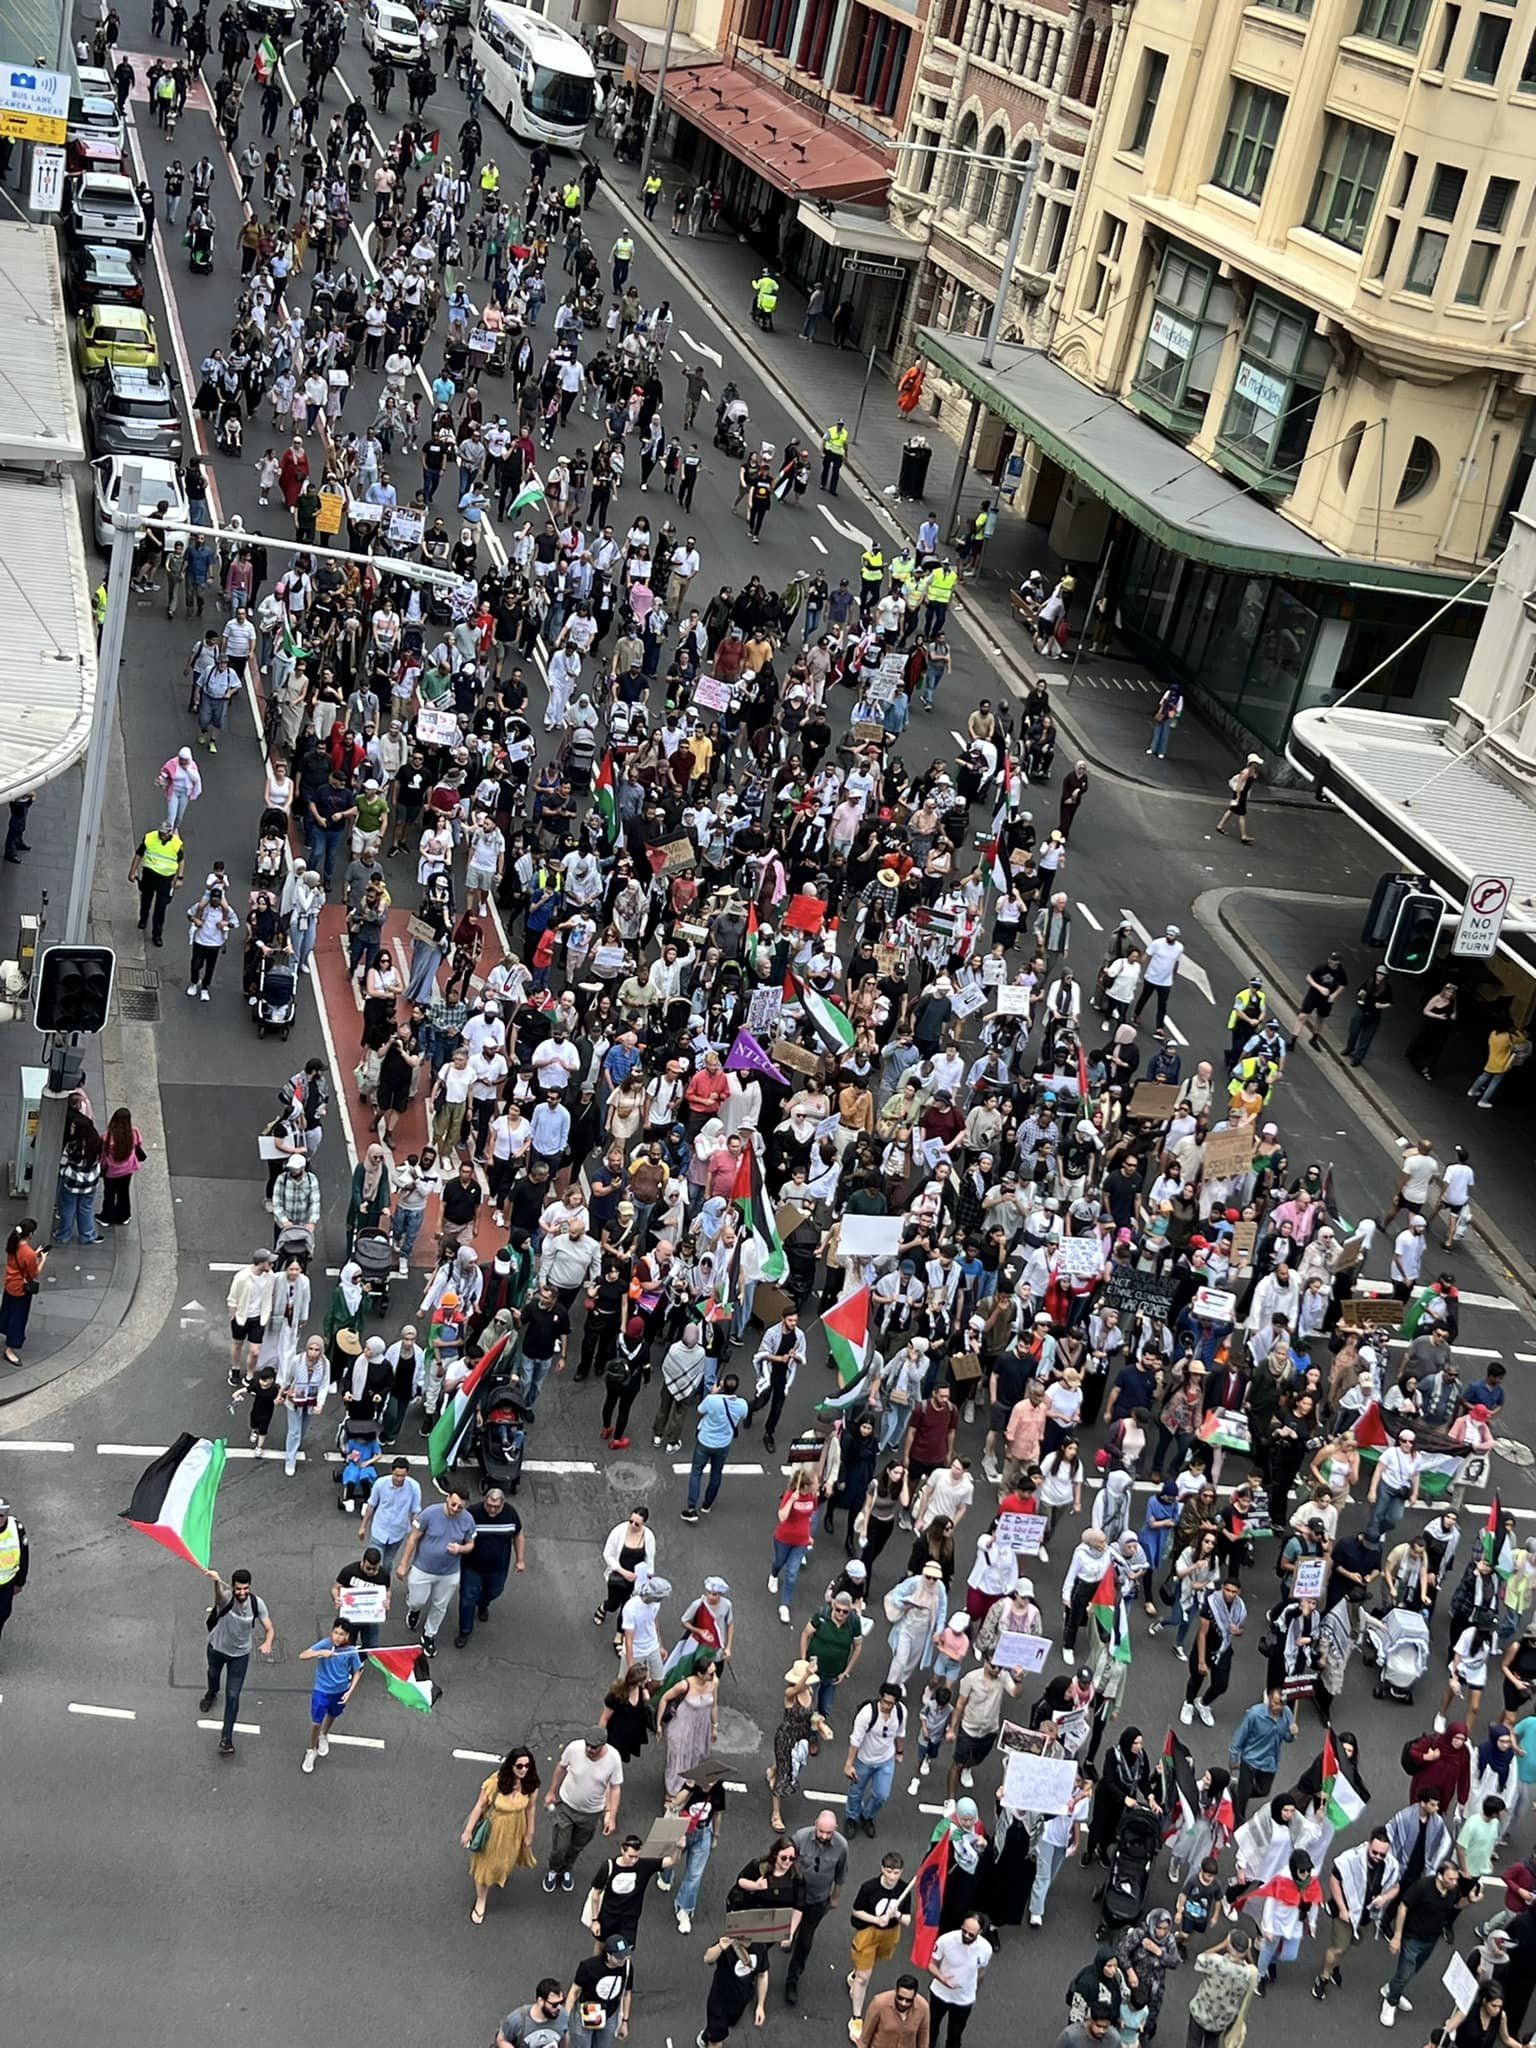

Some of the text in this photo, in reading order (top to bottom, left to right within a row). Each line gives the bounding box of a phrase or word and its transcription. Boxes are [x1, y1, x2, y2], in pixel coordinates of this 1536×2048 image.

[12, 91, 52, 104] BUS LANE
[36, 106, 64, 116] AHEAD
[38, 159, 60, 167] LANE
[1470, 917, 1491, 929] NO
[1461, 930, 1494, 940] RIGHT
[1460, 942, 1490, 951] TURN
